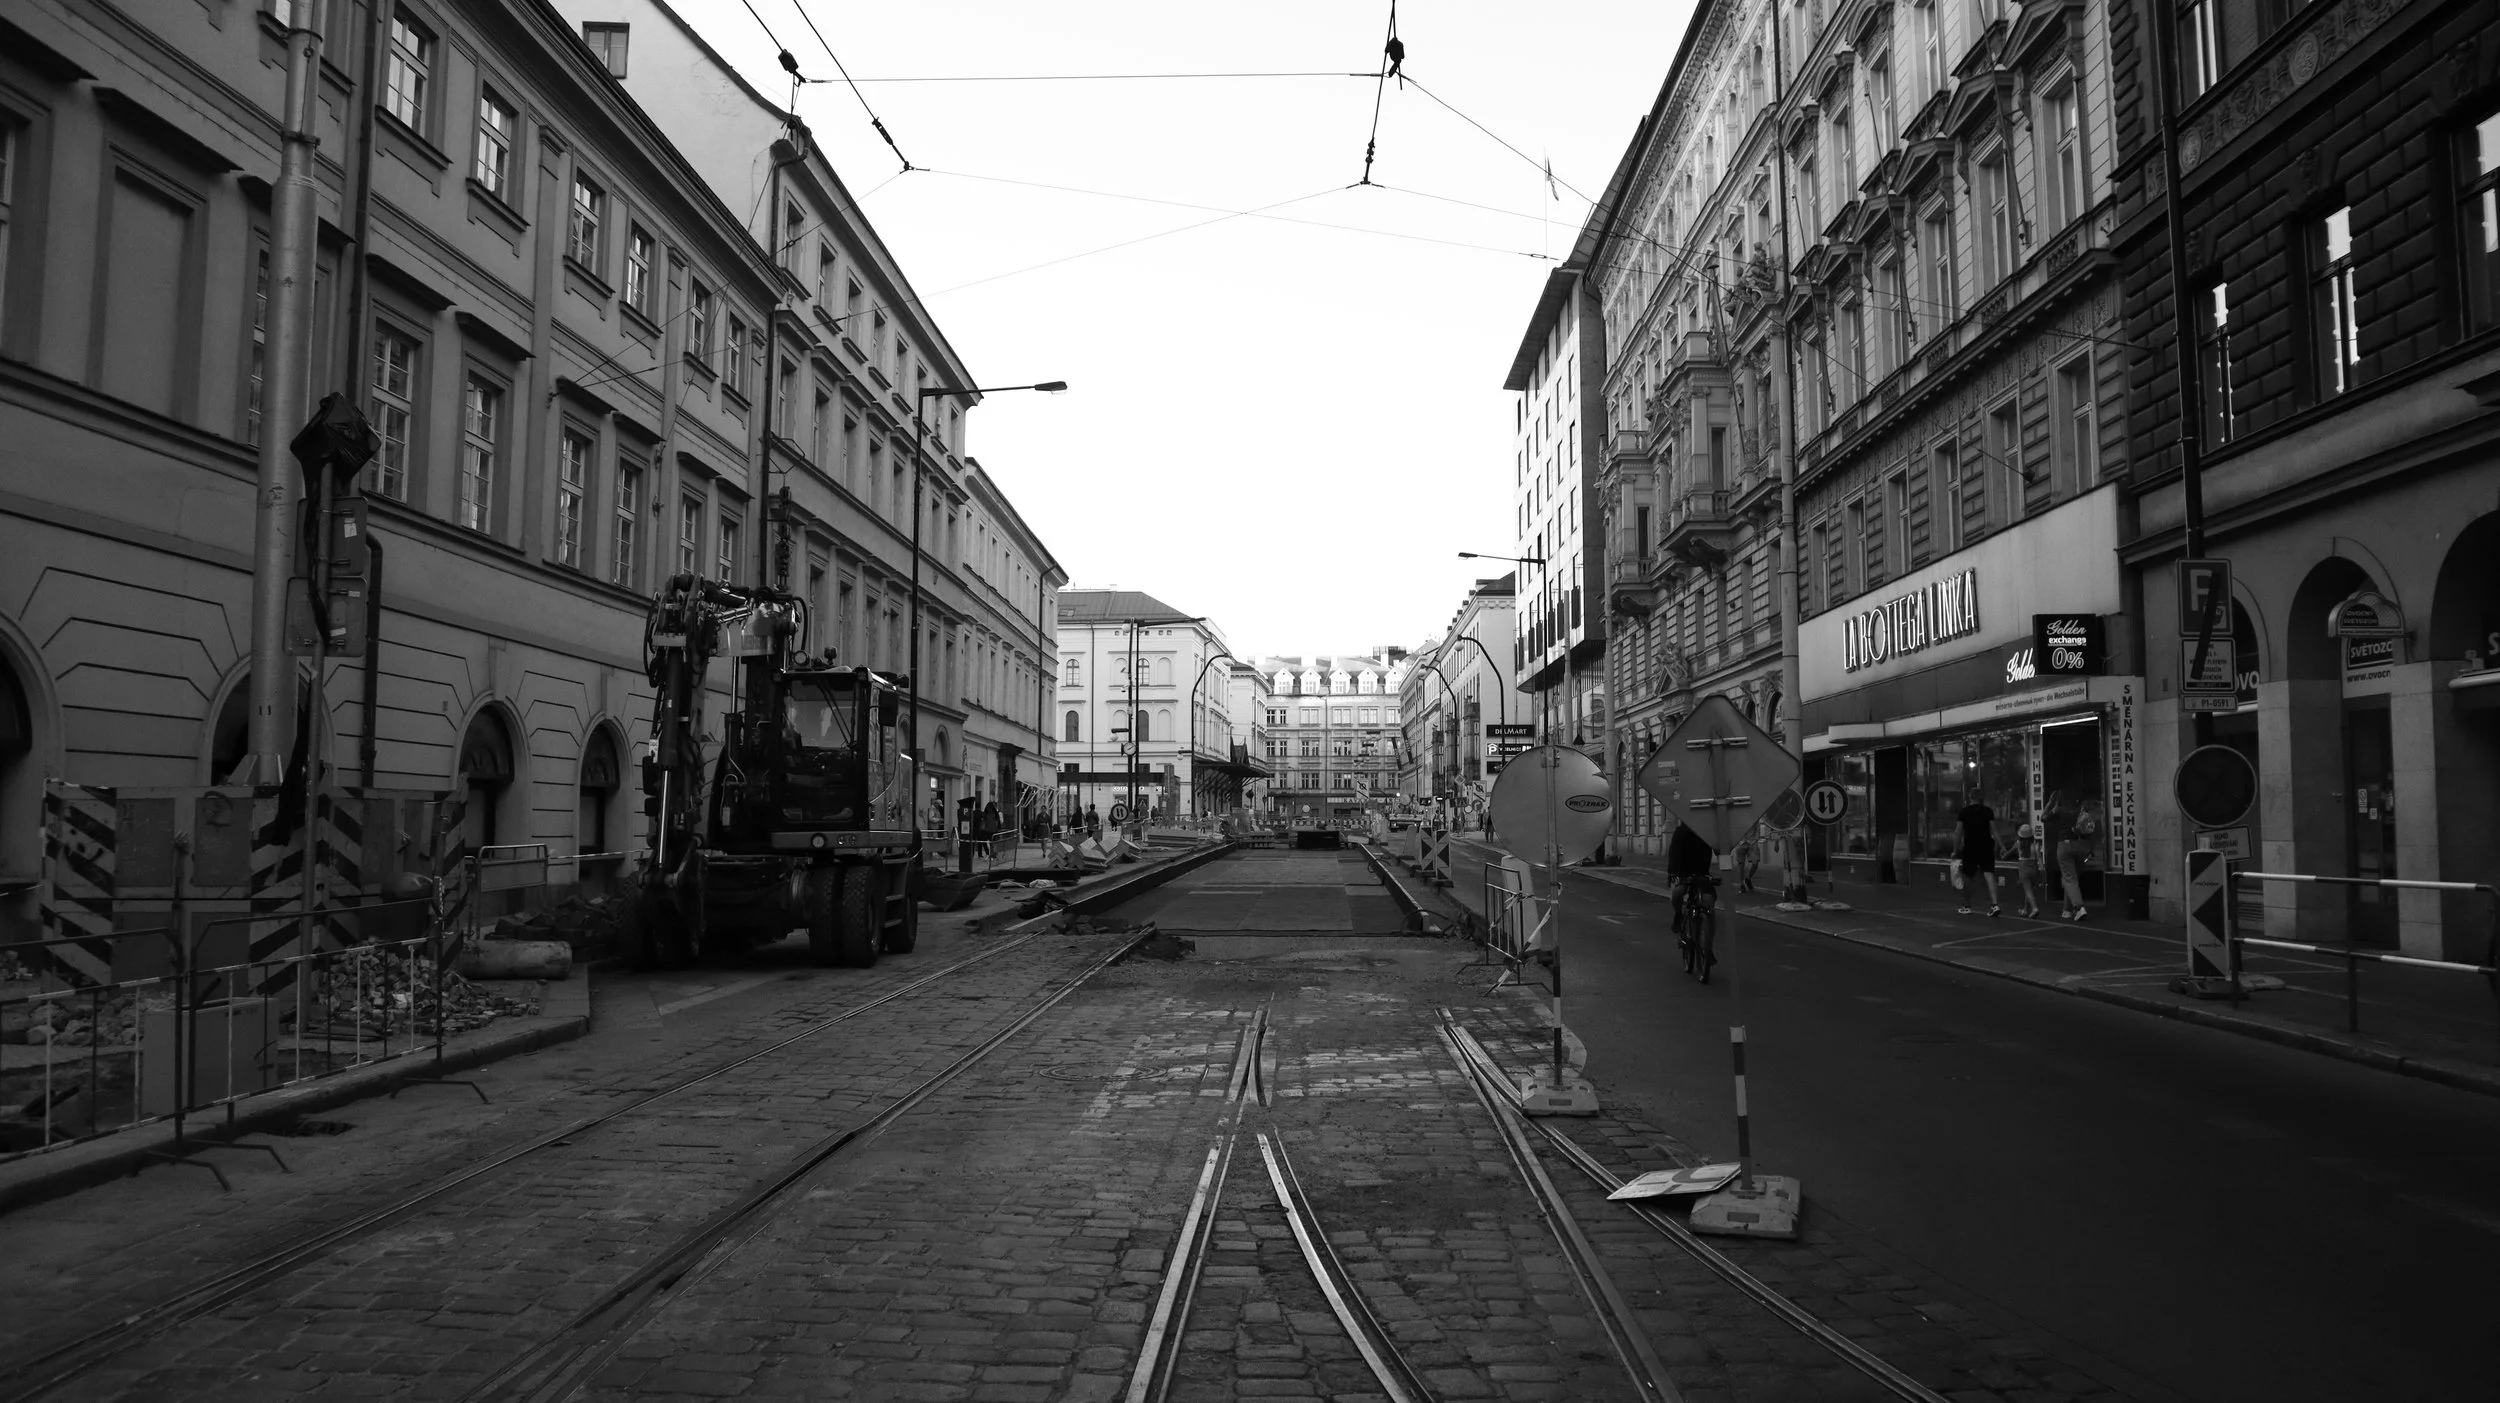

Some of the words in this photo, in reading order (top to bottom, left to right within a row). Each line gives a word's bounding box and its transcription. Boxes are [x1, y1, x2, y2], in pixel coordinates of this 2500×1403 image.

[1841, 616, 1860, 673] LA
[1859, 586, 1930, 667] BOTTEGA
[1930, 566, 1979, 645] LINKA
[2047, 619, 2087, 635] Golden
[2048, 635, 2087, 646] exchange
[2006, 648, 2036, 683] Golde
[2052, 647, 2085, 670] 0%
[2122, 684, 2133, 774] SMĚNÁRNA
[2126, 781, 2136, 871] EXCHANGE
